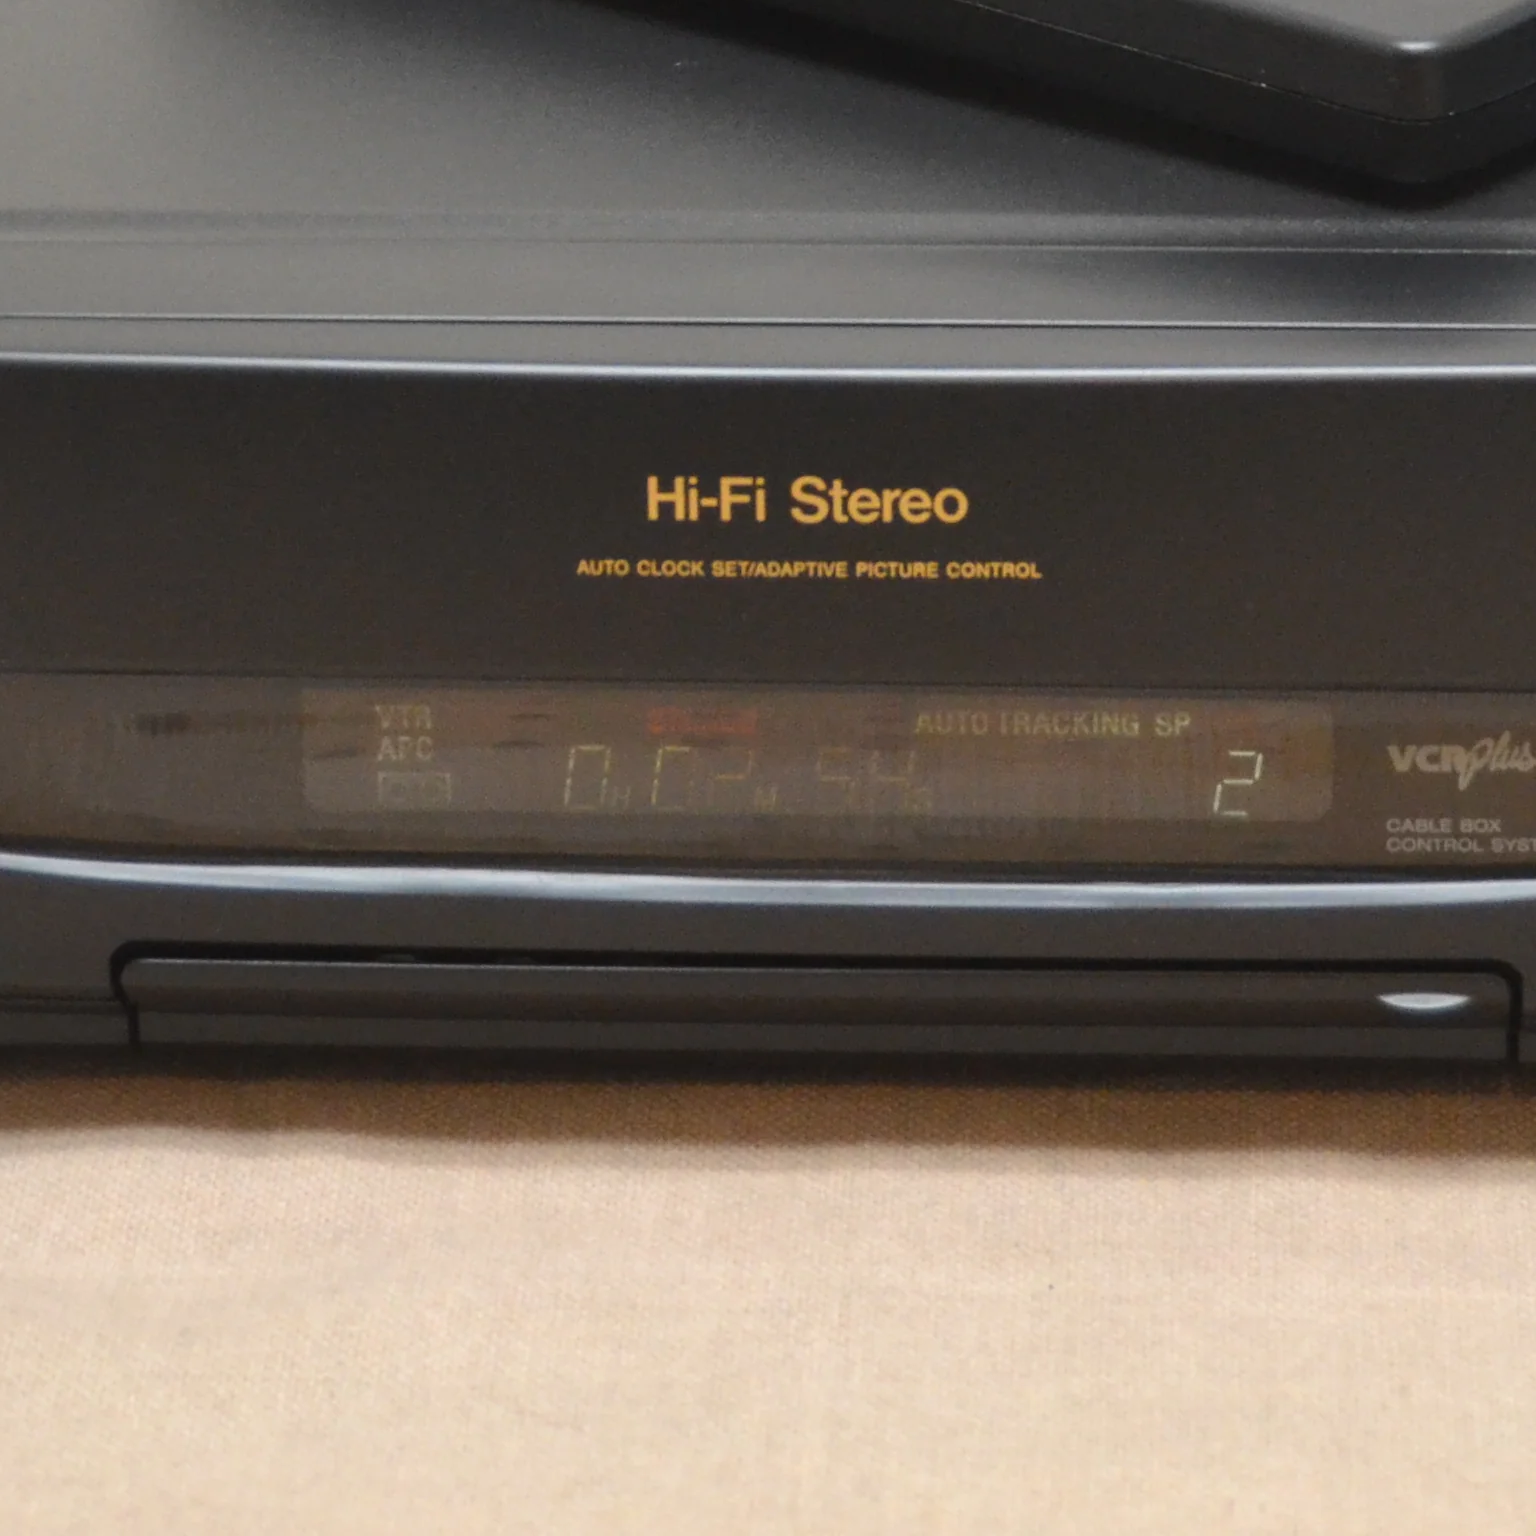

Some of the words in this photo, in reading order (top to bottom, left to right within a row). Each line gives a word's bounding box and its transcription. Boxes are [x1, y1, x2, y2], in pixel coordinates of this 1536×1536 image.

[647, 475, 766, 522] Hi-Fi
[790, 475, 968, 524] Stereo
[577, 559, 629, 577] AUTO
[636, 560, 704, 578] CLOCK
[711, 560, 848, 579] SET/ADAPTIVE
[856, 561, 939, 580] PICTURE
[946, 561, 1042, 581] CONTROL
[914, 712, 989, 736] AUTO
[1000, 712, 1141, 736] TRACKING
[1154, 712, 1193, 736] SP
[1213, 750, 1264, 815] 2
[1385, 817, 1452, 833] CABLE
[1459, 817, 1502, 833] BOX
[1385, 837, 1484, 853] CONTROL
